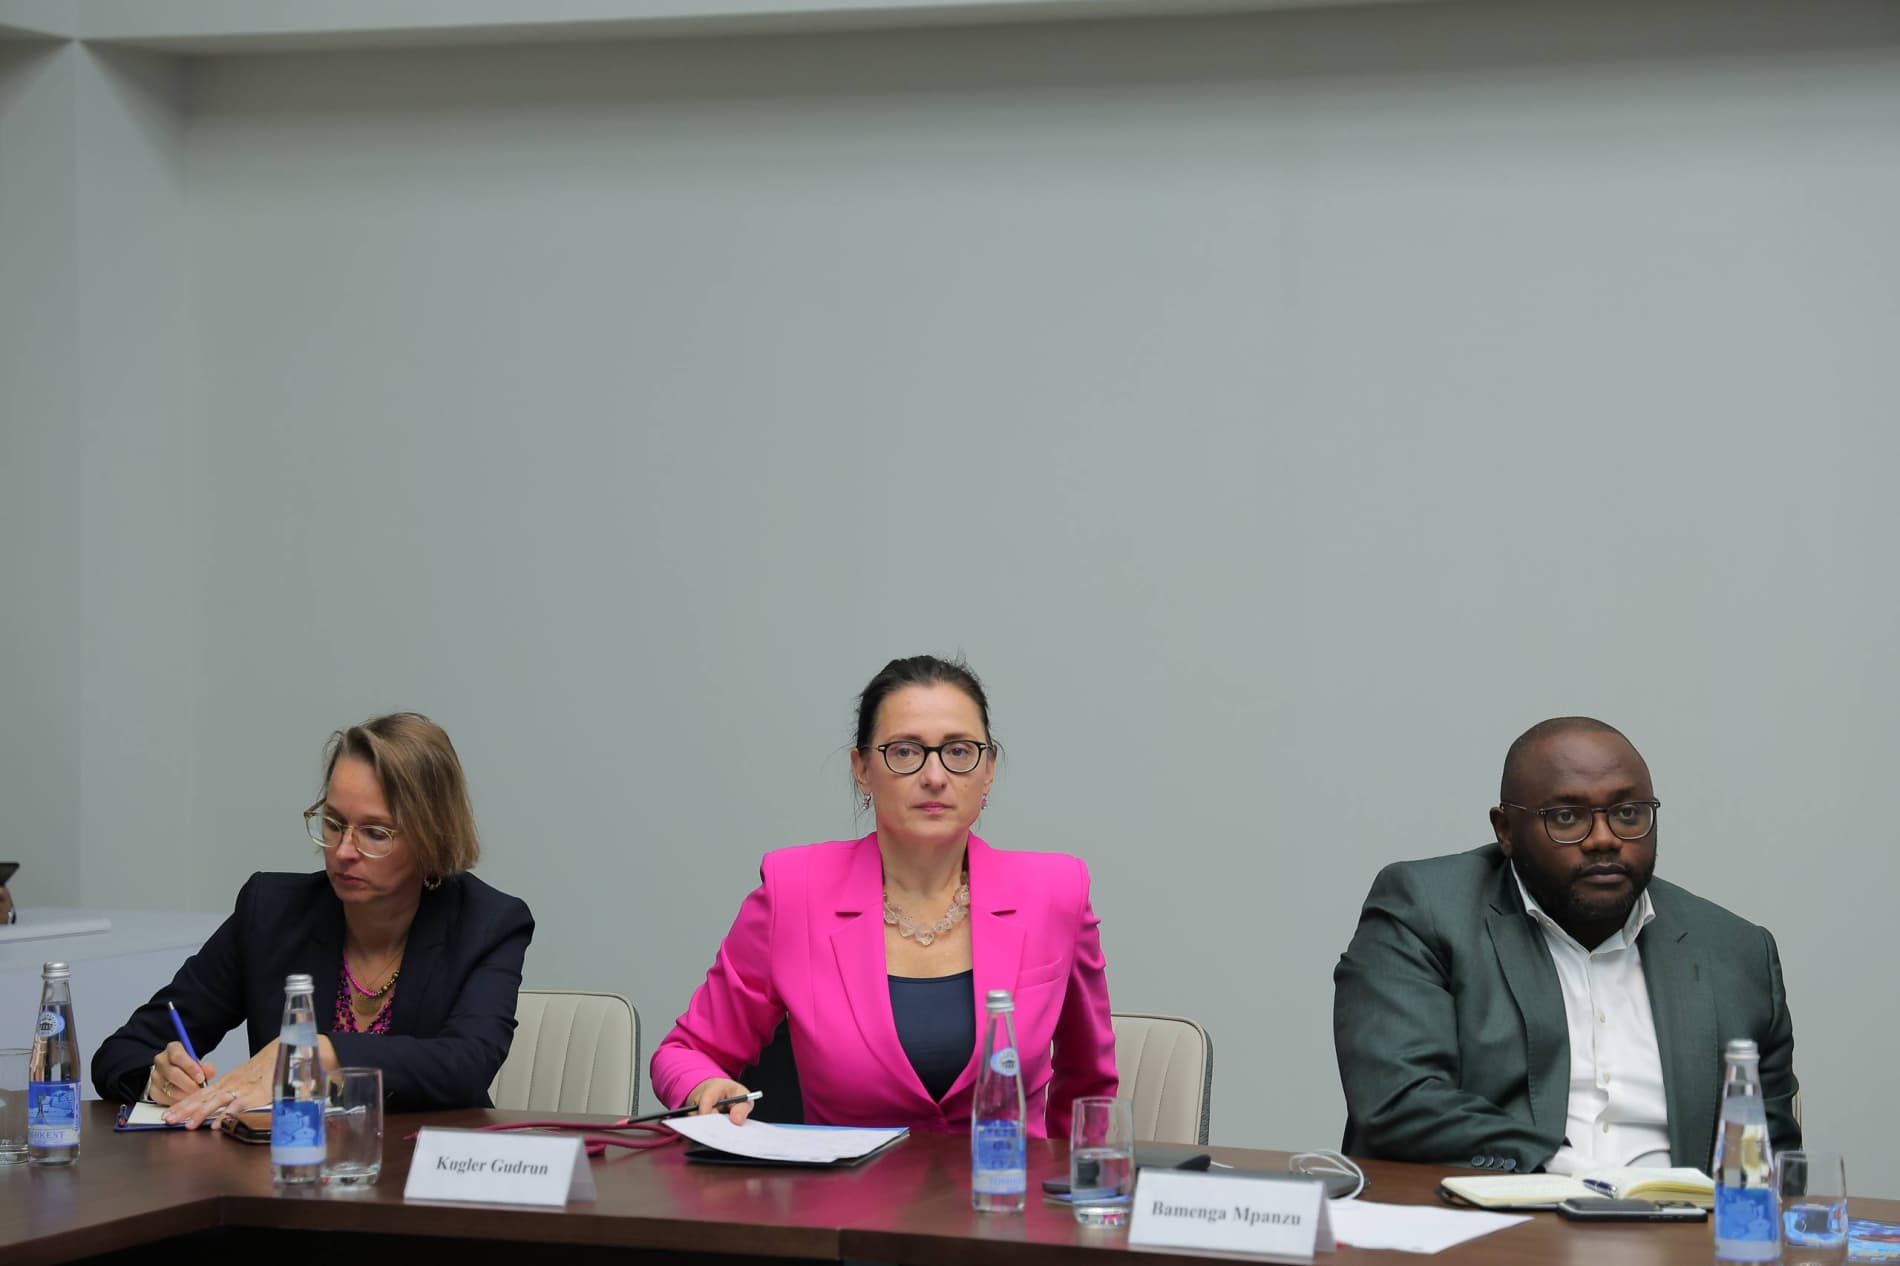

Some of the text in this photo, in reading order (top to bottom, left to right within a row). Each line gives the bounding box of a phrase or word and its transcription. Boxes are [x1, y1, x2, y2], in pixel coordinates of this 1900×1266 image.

[436, 1156, 548, 1175] Kugler Gudrun
[1152, 1201, 1301, 1226] Bamenga Mpanzu
